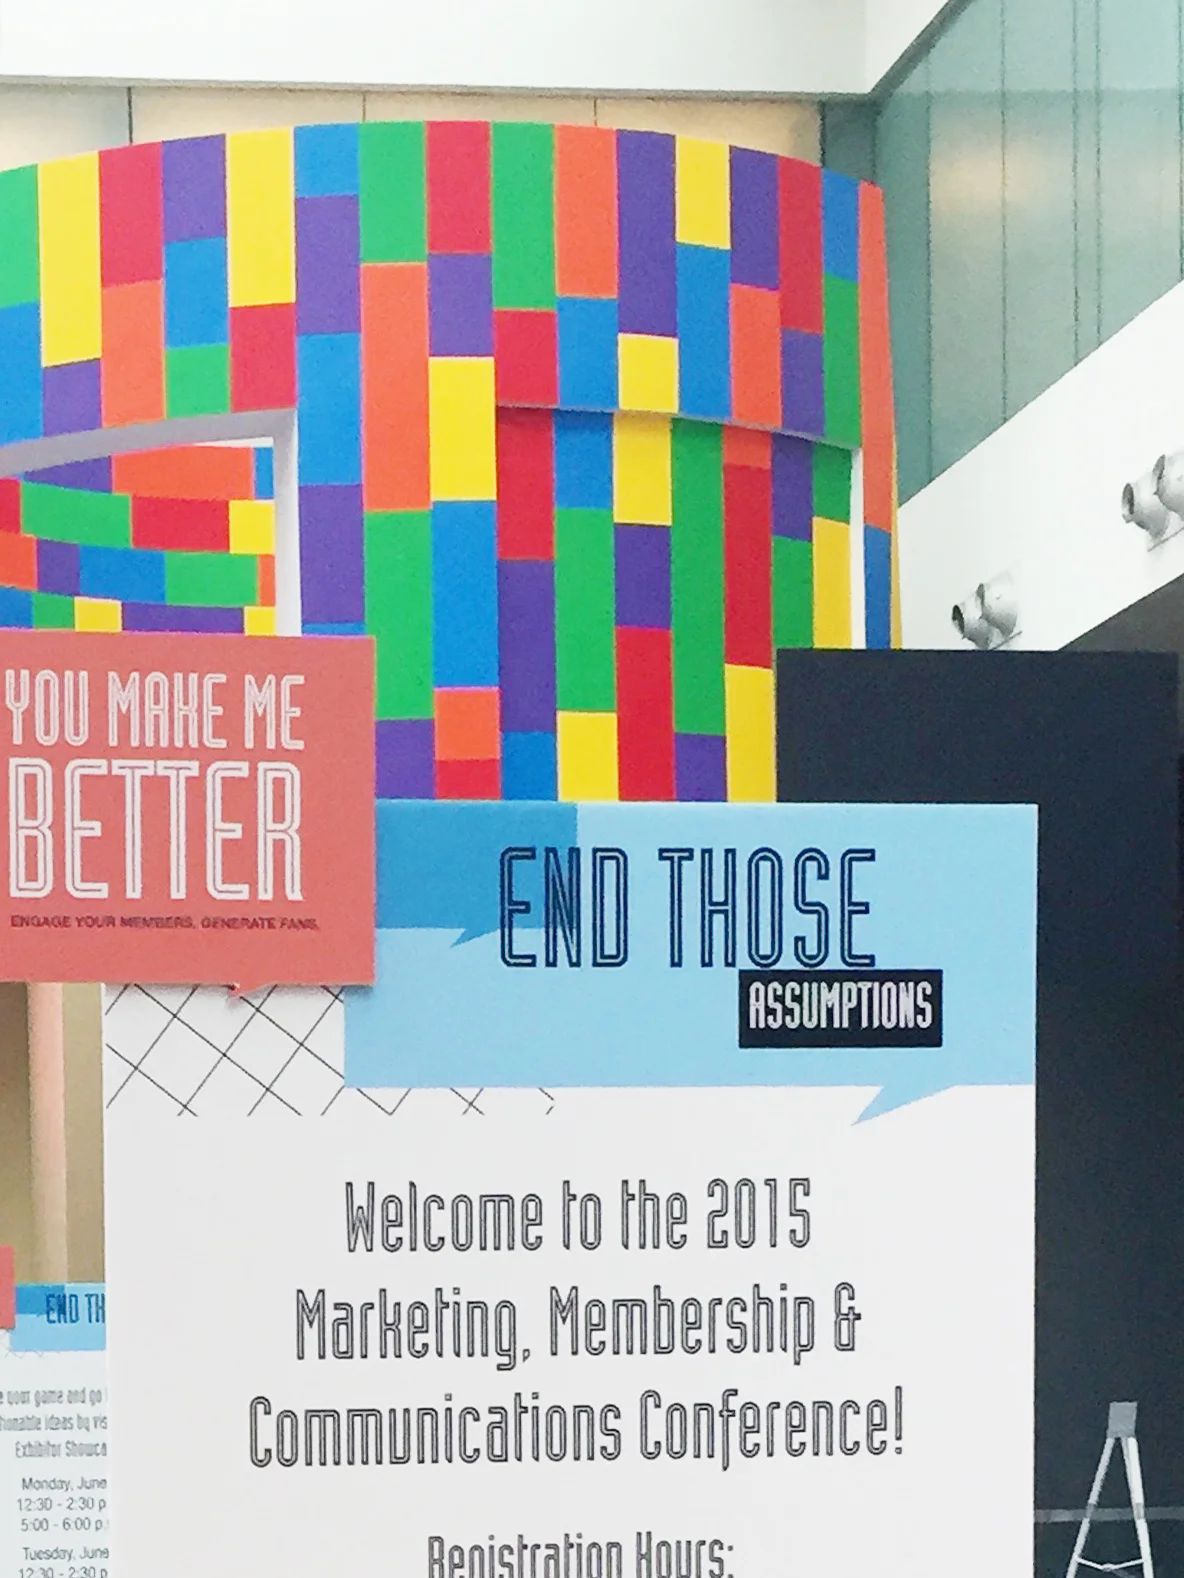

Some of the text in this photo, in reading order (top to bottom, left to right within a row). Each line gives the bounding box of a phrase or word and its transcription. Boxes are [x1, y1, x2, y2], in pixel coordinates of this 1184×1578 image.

[5, 669, 305, 749] YOU MAKE ME
[8, 757, 305, 900] BETTER
[10, 915, 70, 928] ENGAGE
[75, 915, 115, 928] YOUR
[201, 917, 276, 929] GENERATE
[499, 847, 876, 969] END THOSE
[749, 981, 932, 1029] ASSUMPTIONS
[345, 1178, 811, 1252] Welcome to the 2015
[45, 1294, 79, 1324] END
[296, 1282, 861, 1371] Marketing, Membership &
[249, 1386, 903, 1471] Communications Conference!
[18, 1497, 53, 1512] 12:30
[67, 1497, 94, 1511] 2:30
[22, 1476, 107, 1492] Monday, June
[20, 1518, 49, 1532] 5:00
[62, 1517, 91, 1531] 6:00
[22, 1546, 109, 1562] Tuesday, June
